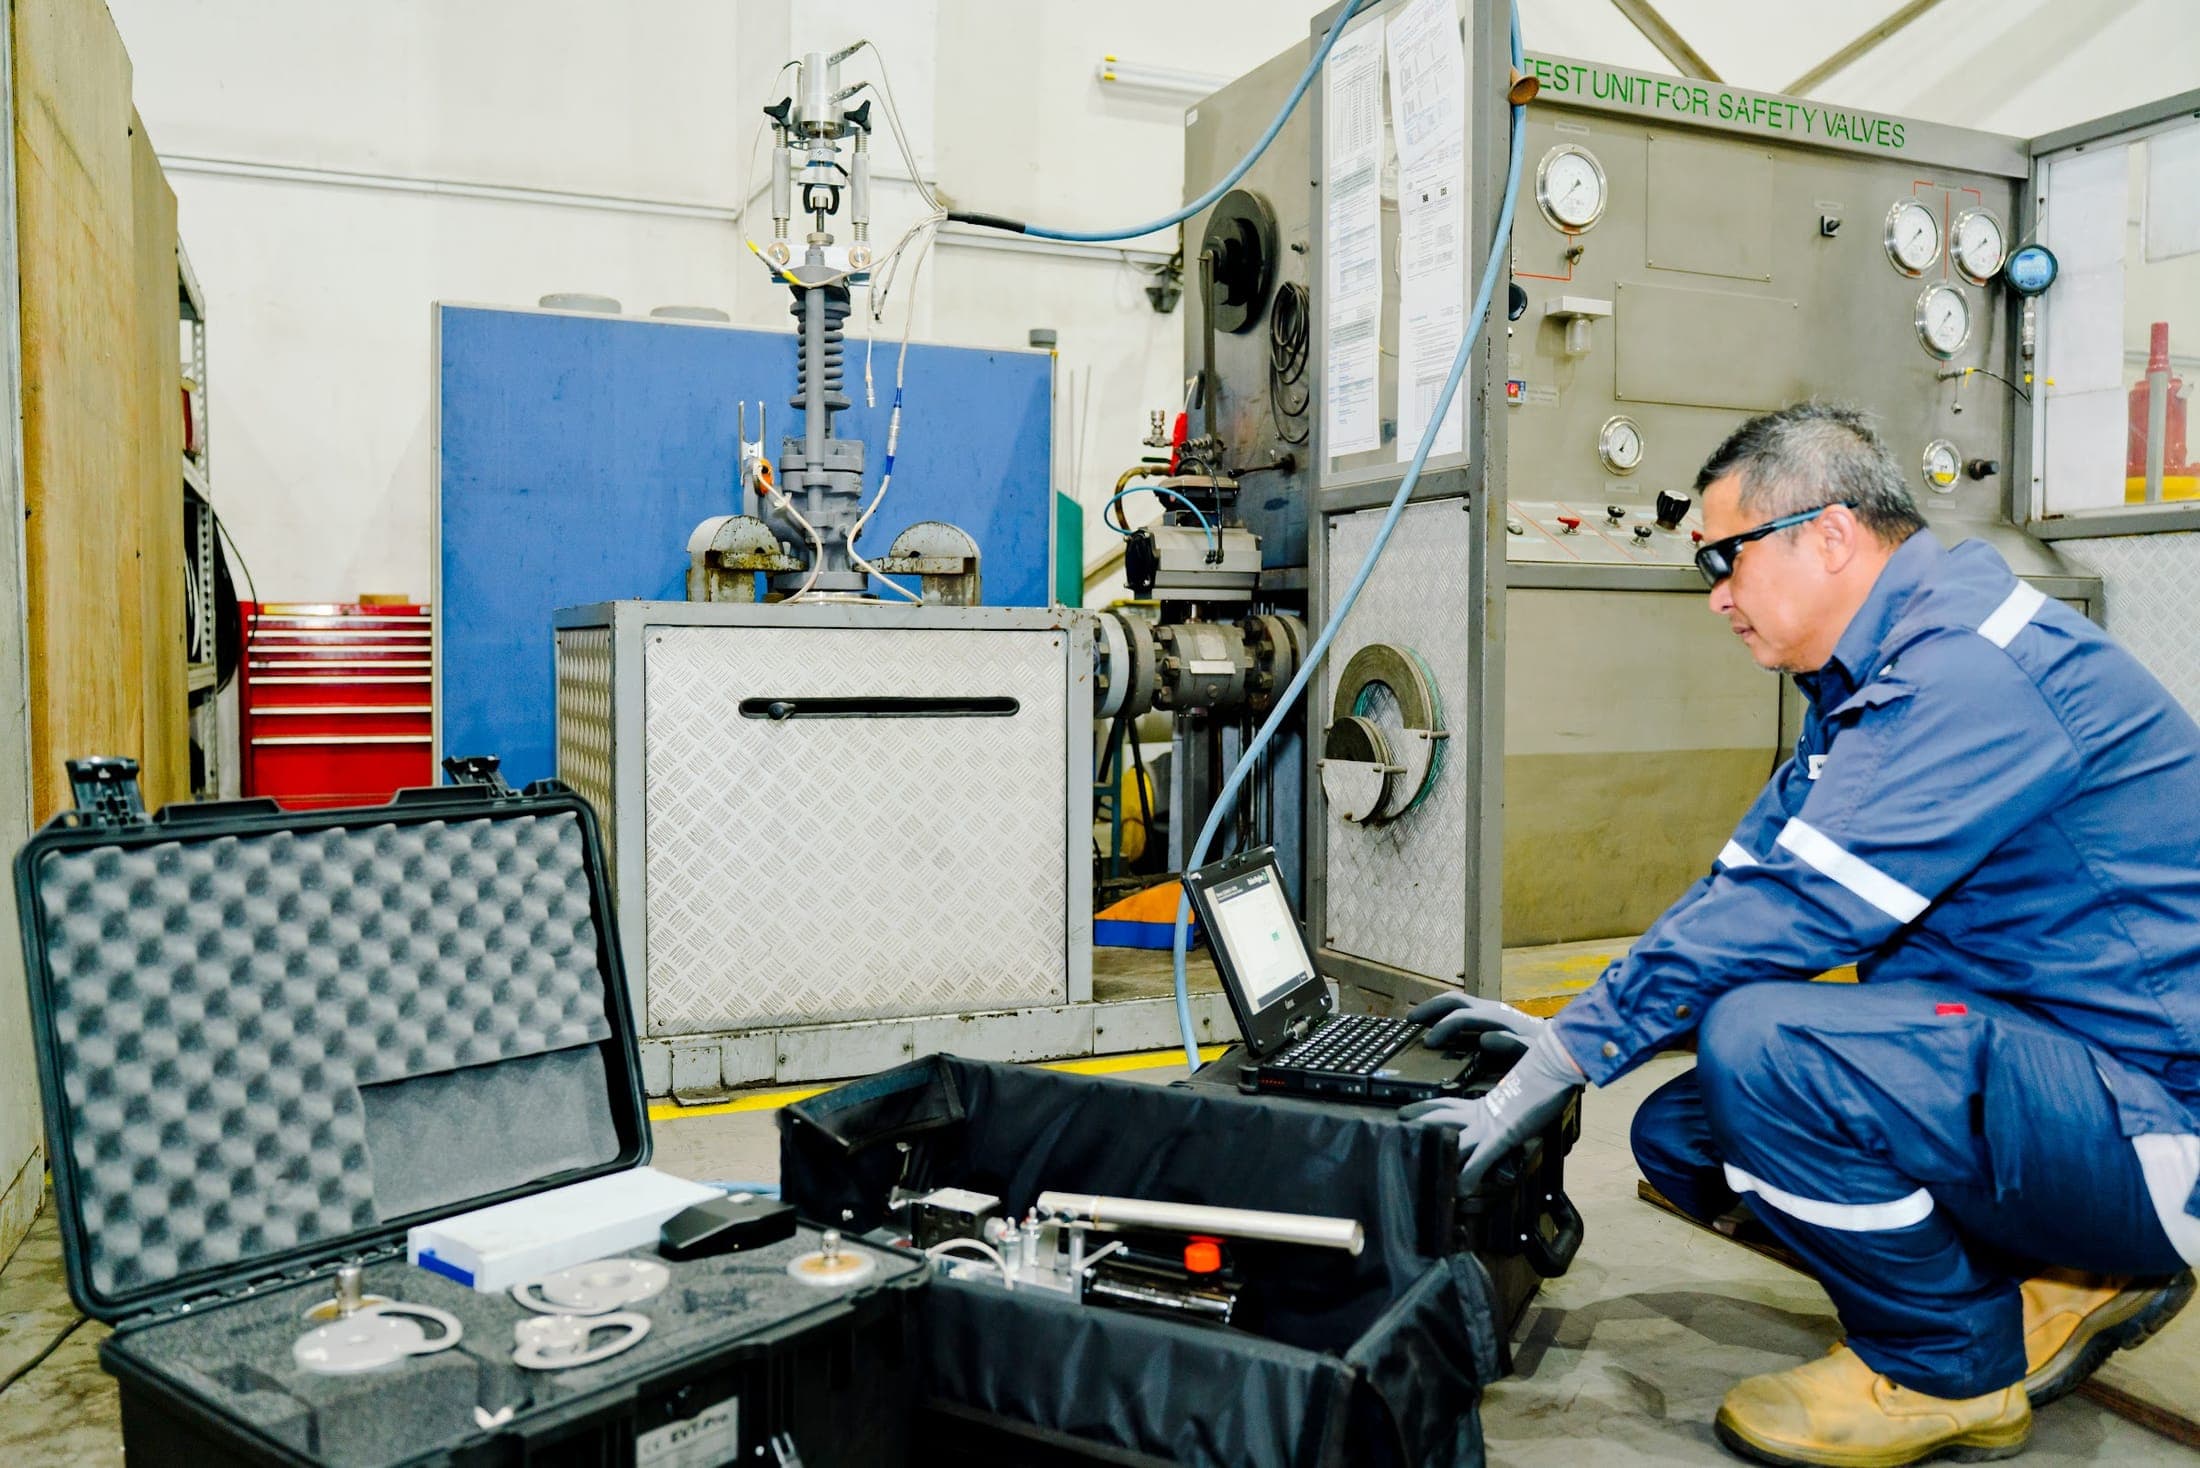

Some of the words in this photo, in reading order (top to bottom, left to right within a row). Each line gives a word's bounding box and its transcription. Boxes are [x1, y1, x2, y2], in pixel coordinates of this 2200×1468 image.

[1591, 71, 1653, 105] UNIT
[1655, 81, 1709, 117] FOR
[1718, 93, 1816, 133] SAFETY
[1823, 110, 1905, 149] VALVES
